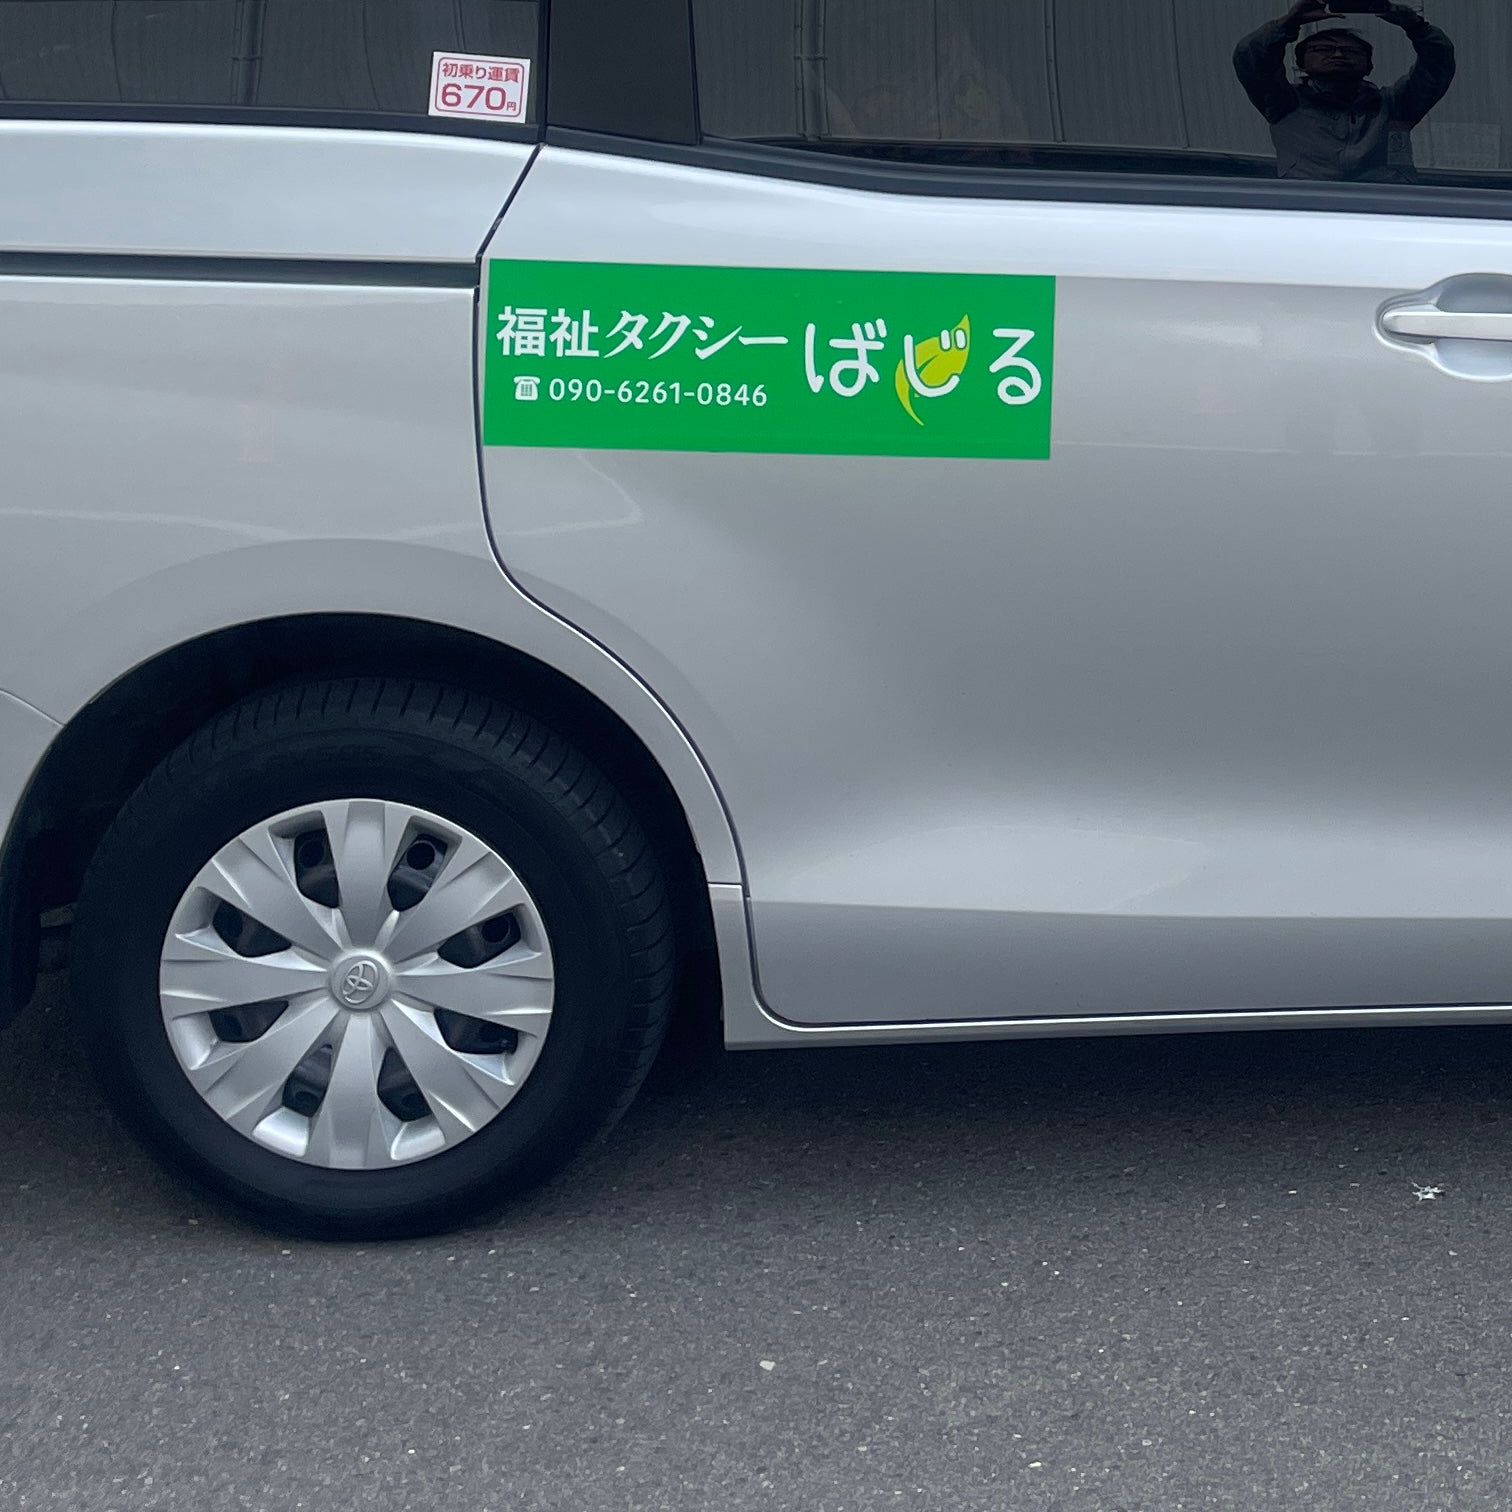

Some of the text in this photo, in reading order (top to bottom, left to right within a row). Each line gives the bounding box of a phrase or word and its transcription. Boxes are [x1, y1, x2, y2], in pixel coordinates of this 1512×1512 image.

[442, 62, 520, 83] 初乗り運賃
[496, 305, 1043, 406] 福祉タクシー ばじる
[549, 377, 768, 407] 090-6261-0846
